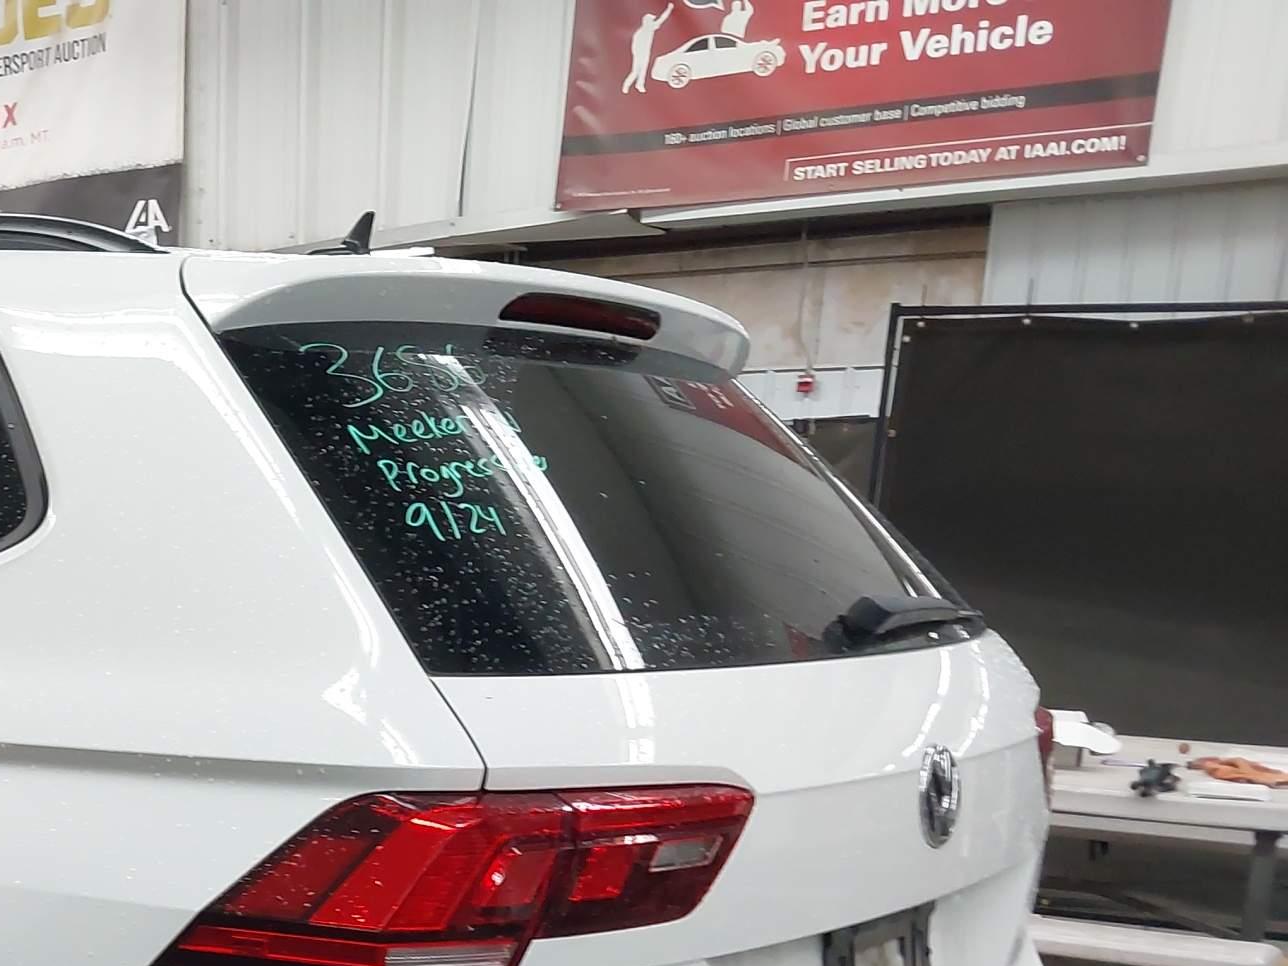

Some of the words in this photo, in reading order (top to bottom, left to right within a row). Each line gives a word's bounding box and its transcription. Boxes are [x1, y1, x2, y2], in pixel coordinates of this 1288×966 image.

[802, 0, 889, 32] Earn
[901, 0, 1008, 17] Mo
[53, 32, 107, 63] AUCTION
[799, 42, 888, 73] Your
[899, 14, 1054, 61] Vehicle
[688, 129, 728, 143] auction
[728, 122, 776, 138] locations
[783, 116, 818, 131] Global
[819, 111, 872, 127] customer
[873, 108, 902, 121] base
[911, 98, 979, 117] Competitive
[980, 94, 1026, 110] bidding
[793, 161, 849, 181] START
[851, 152, 928, 176] SELLING
[928, 147, 992, 168] TODAY
[994, 145, 1018, 162] AT
[1023, 135, 1127, 159] IAAI.COM!
[405, 501, 507, 541] 9/24
